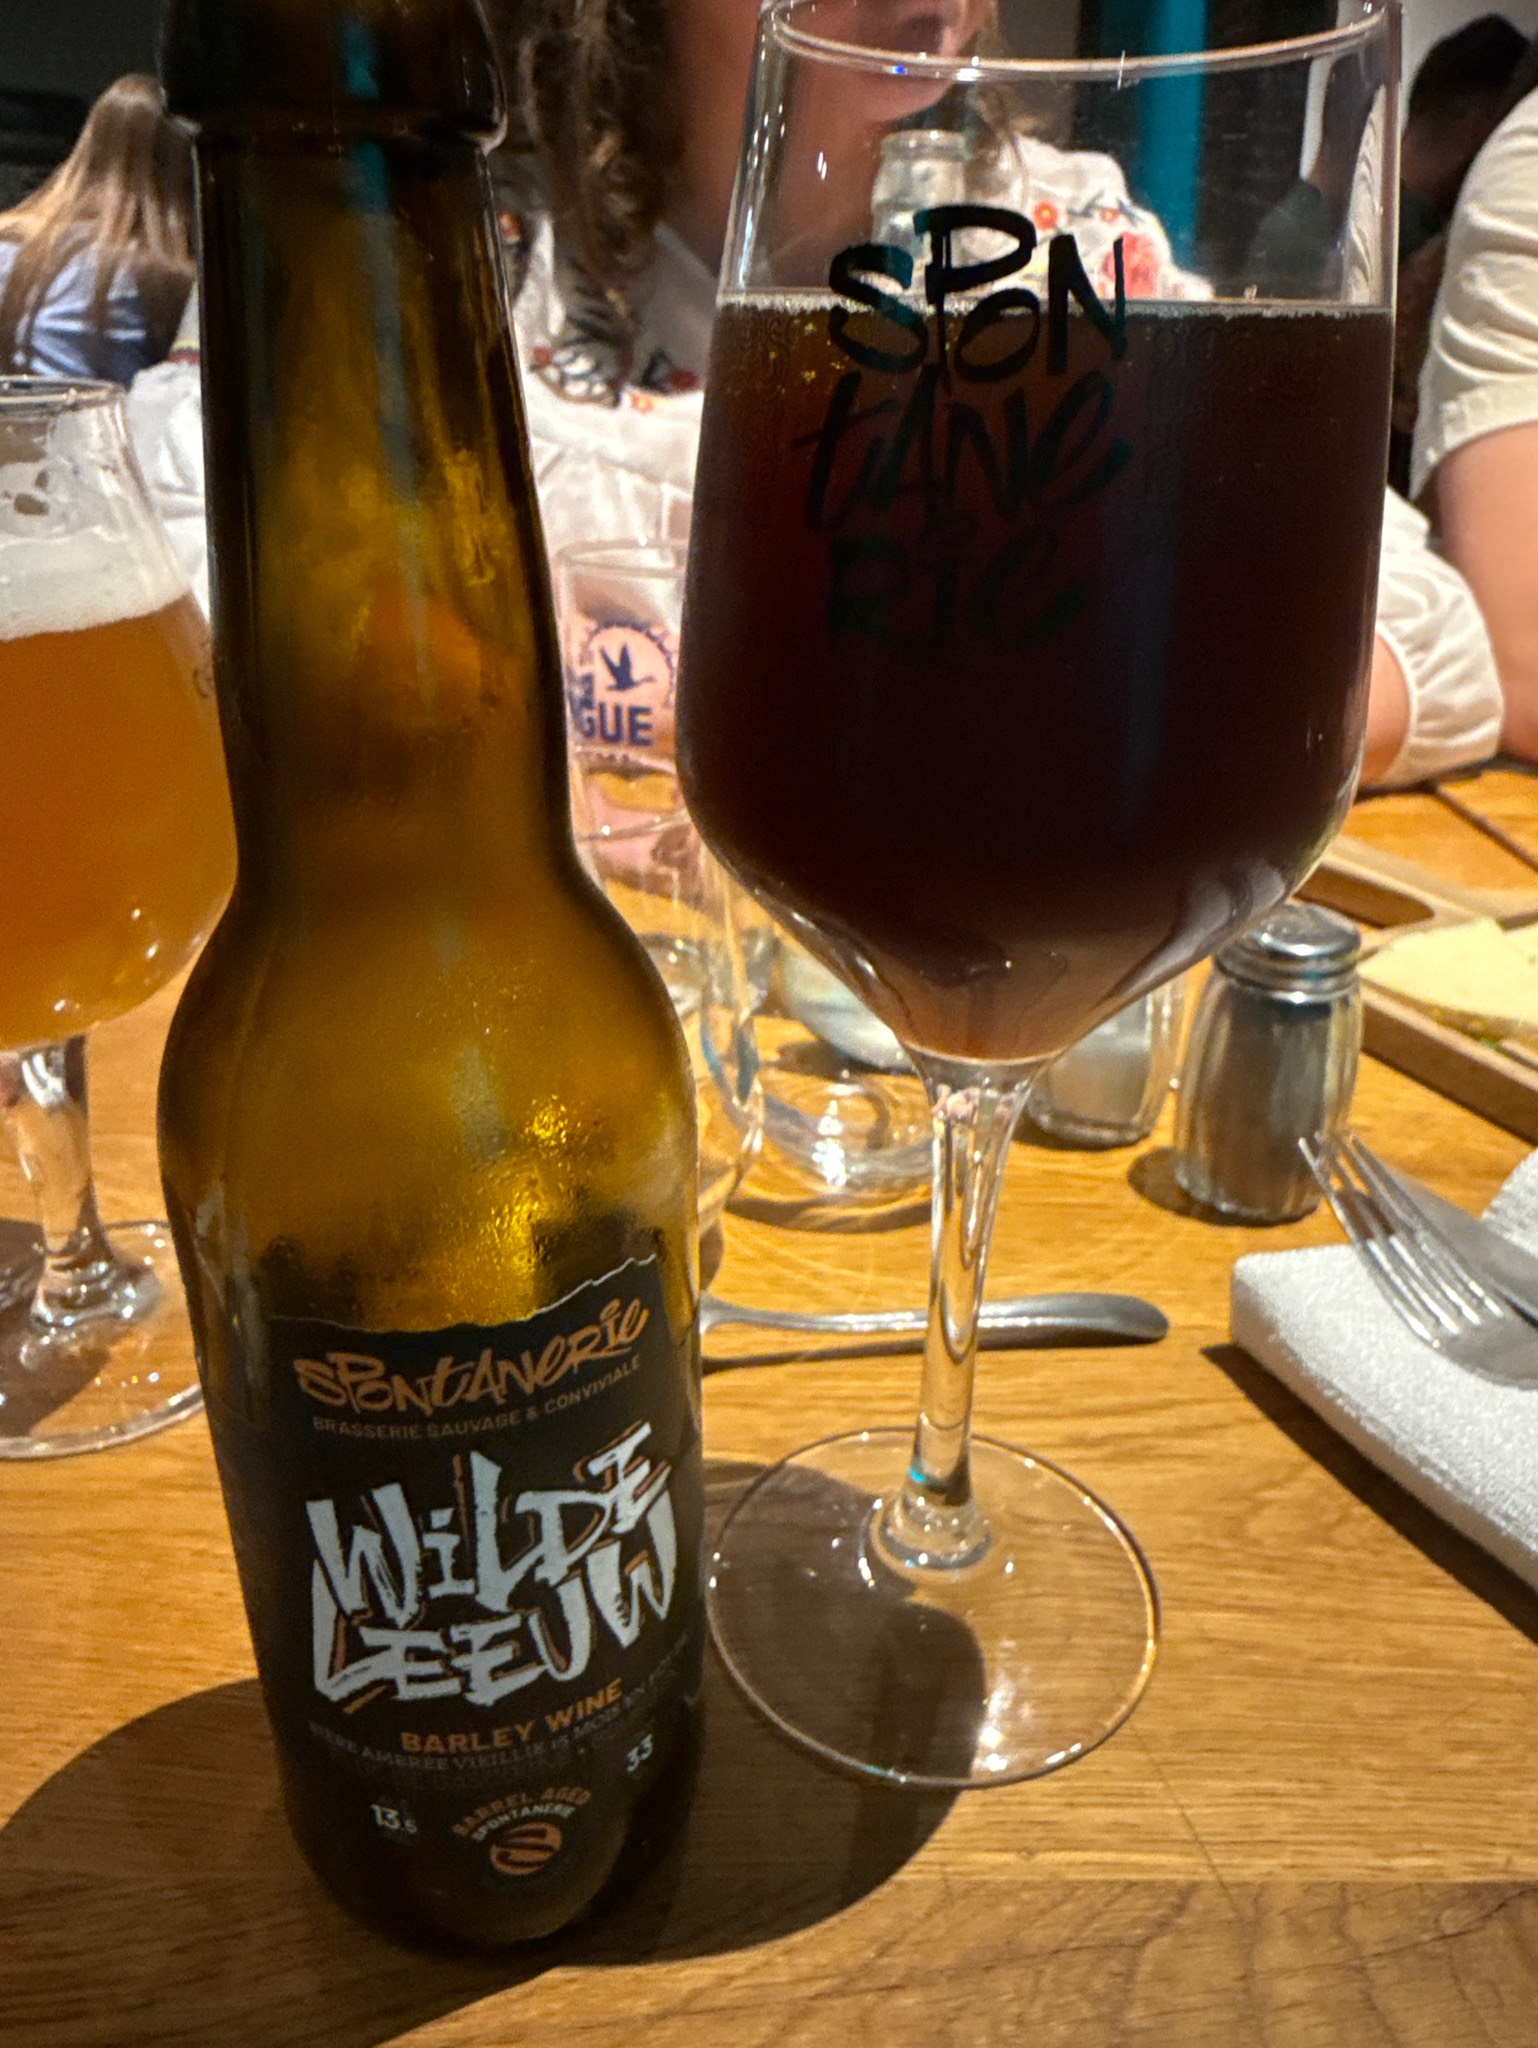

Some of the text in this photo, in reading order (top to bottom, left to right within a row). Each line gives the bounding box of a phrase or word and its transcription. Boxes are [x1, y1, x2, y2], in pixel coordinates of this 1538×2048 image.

[829, 204, 1128, 388] SPON
[313, 1354, 641, 1440] BRASSERIE SAUVAGE & CONVIVIALE
[311, 1489, 677, 1708] LEEUW
[400, 1720, 536, 1753] BARLEY
[544, 1677, 624, 1731] WINE
[627, 1734, 653, 1773] 33
[541, 1786, 593, 1806] AGED
